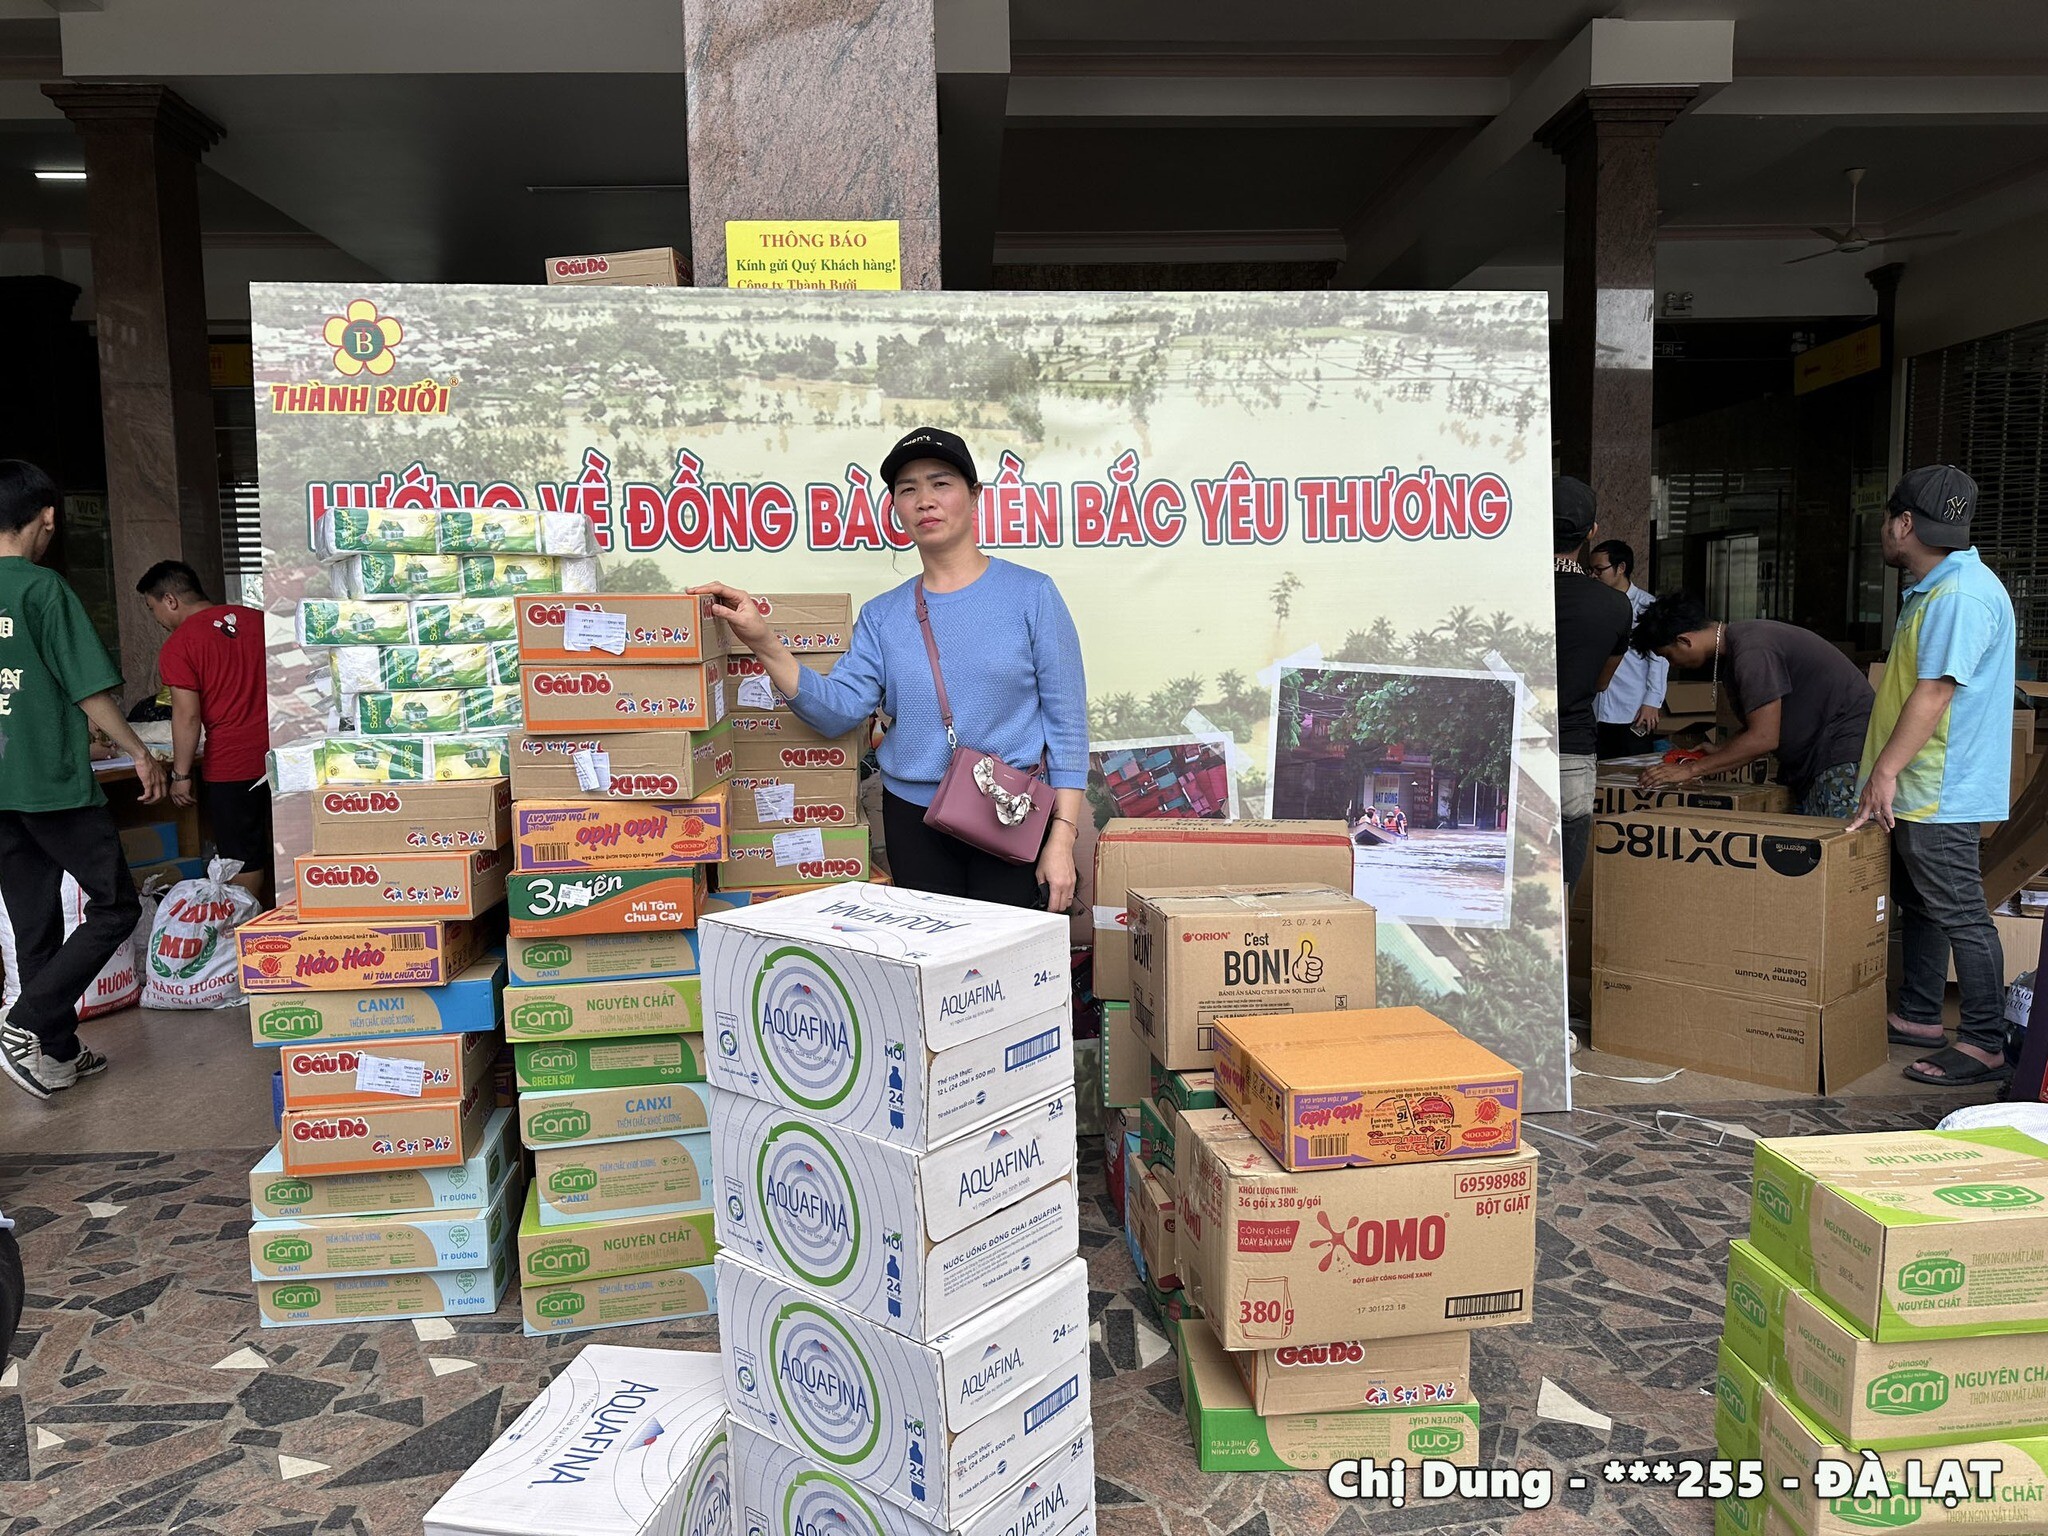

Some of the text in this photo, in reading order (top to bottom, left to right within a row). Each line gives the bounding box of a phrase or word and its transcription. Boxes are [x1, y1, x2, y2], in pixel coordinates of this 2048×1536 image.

[759, 230, 867, 247] THÔNG BÁO
[736, 259, 896, 273] Kính gửi Quý Khách hàng!
[788, 280, 826, 290] Thành
[272, 379, 450, 414] THÀNH BƯỞI
[623, 446, 799, 552] ĐỒNG
[971, 450, 1063, 550] IỀN
[1070, 448, 1186, 550] BẮC
[1194, 460, 1288, 546] YÊU
[1297, 465, 1511, 543] THƯƠNG
[661, 626, 691, 643] Phở
[816, 634, 841, 646] Phở
[615, 698, 697, 714] Gà Phở
[457, 830, 487, 846] Phở
[433, 886, 461, 901] Phở
[527, 878, 557, 916] 3
[632, 901, 677, 912] Mì Tôm
[624, 912, 683, 923] Chua Cay
[817, 900, 972, 934] AQUAFINA
[1312, 918, 1321, 926] 24
[158, 934, 203, 959] MD
[296, 942, 385, 977] Hảo Hảo
[1223, 948, 1290, 986] BON!
[189, 973, 235, 995] HƯƠNG
[363, 969, 432, 980] MÌ TÔM CHUA CAY
[1034, 970, 1048, 987] 24
[357, 998, 405, 1013] CANXI
[586, 990, 676, 1011] NGUYÊN CHẤT
[940, 979, 1004, 1022] AQUAFINA
[762, 1003, 852, 1059] AQUAFINA
[532, 1074, 576, 1087] GREEN SOY
[625, 1096, 672, 1113] CANXI
[888, 1090, 905, 1106] 24
[1048, 1098, 1063, 1116] 24
[424, 1136, 452, 1151] Phở
[958, 1138, 1042, 1208] AQUAFINA
[1459, 1171, 1526, 1193] 69598988
[766, 1174, 850, 1241] AQUAFINA
[1238, 1195, 1321, 1210] 36 gói x 380 g/gói
[1475, 1193, 1531, 1219] BỘT GIẶT
[1028, 1203, 1062, 1225] AQUAFINA
[603, 1225, 692, 1251] NGUYÊN CHẤT
[1274, 1237, 1292, 1246] XANH
[1357, 1215, 1446, 1266] OMO
[887, 1278, 901, 1295] 24
[1239, 1300, 1294, 1325] 380 g
[1896, 1297, 1961, 1311] NGUYÊN CHẤT
[1052, 1324, 1067, 1344] 24
[960, 1348, 1022, 1404] AQUAFINA
[1954, 1367, 2019, 1388] NGUYÊN
[780, 1349, 871, 1423] AQUAFINA
[1423, 1382, 1456, 1401] Phở
[531, 1380, 659, 1484] AQUAFINA
[1071, 1438, 1084, 1457] 24
[909, 1463, 925, 1480] 24
[2002, 1478, 2044, 1503] CHẤT
